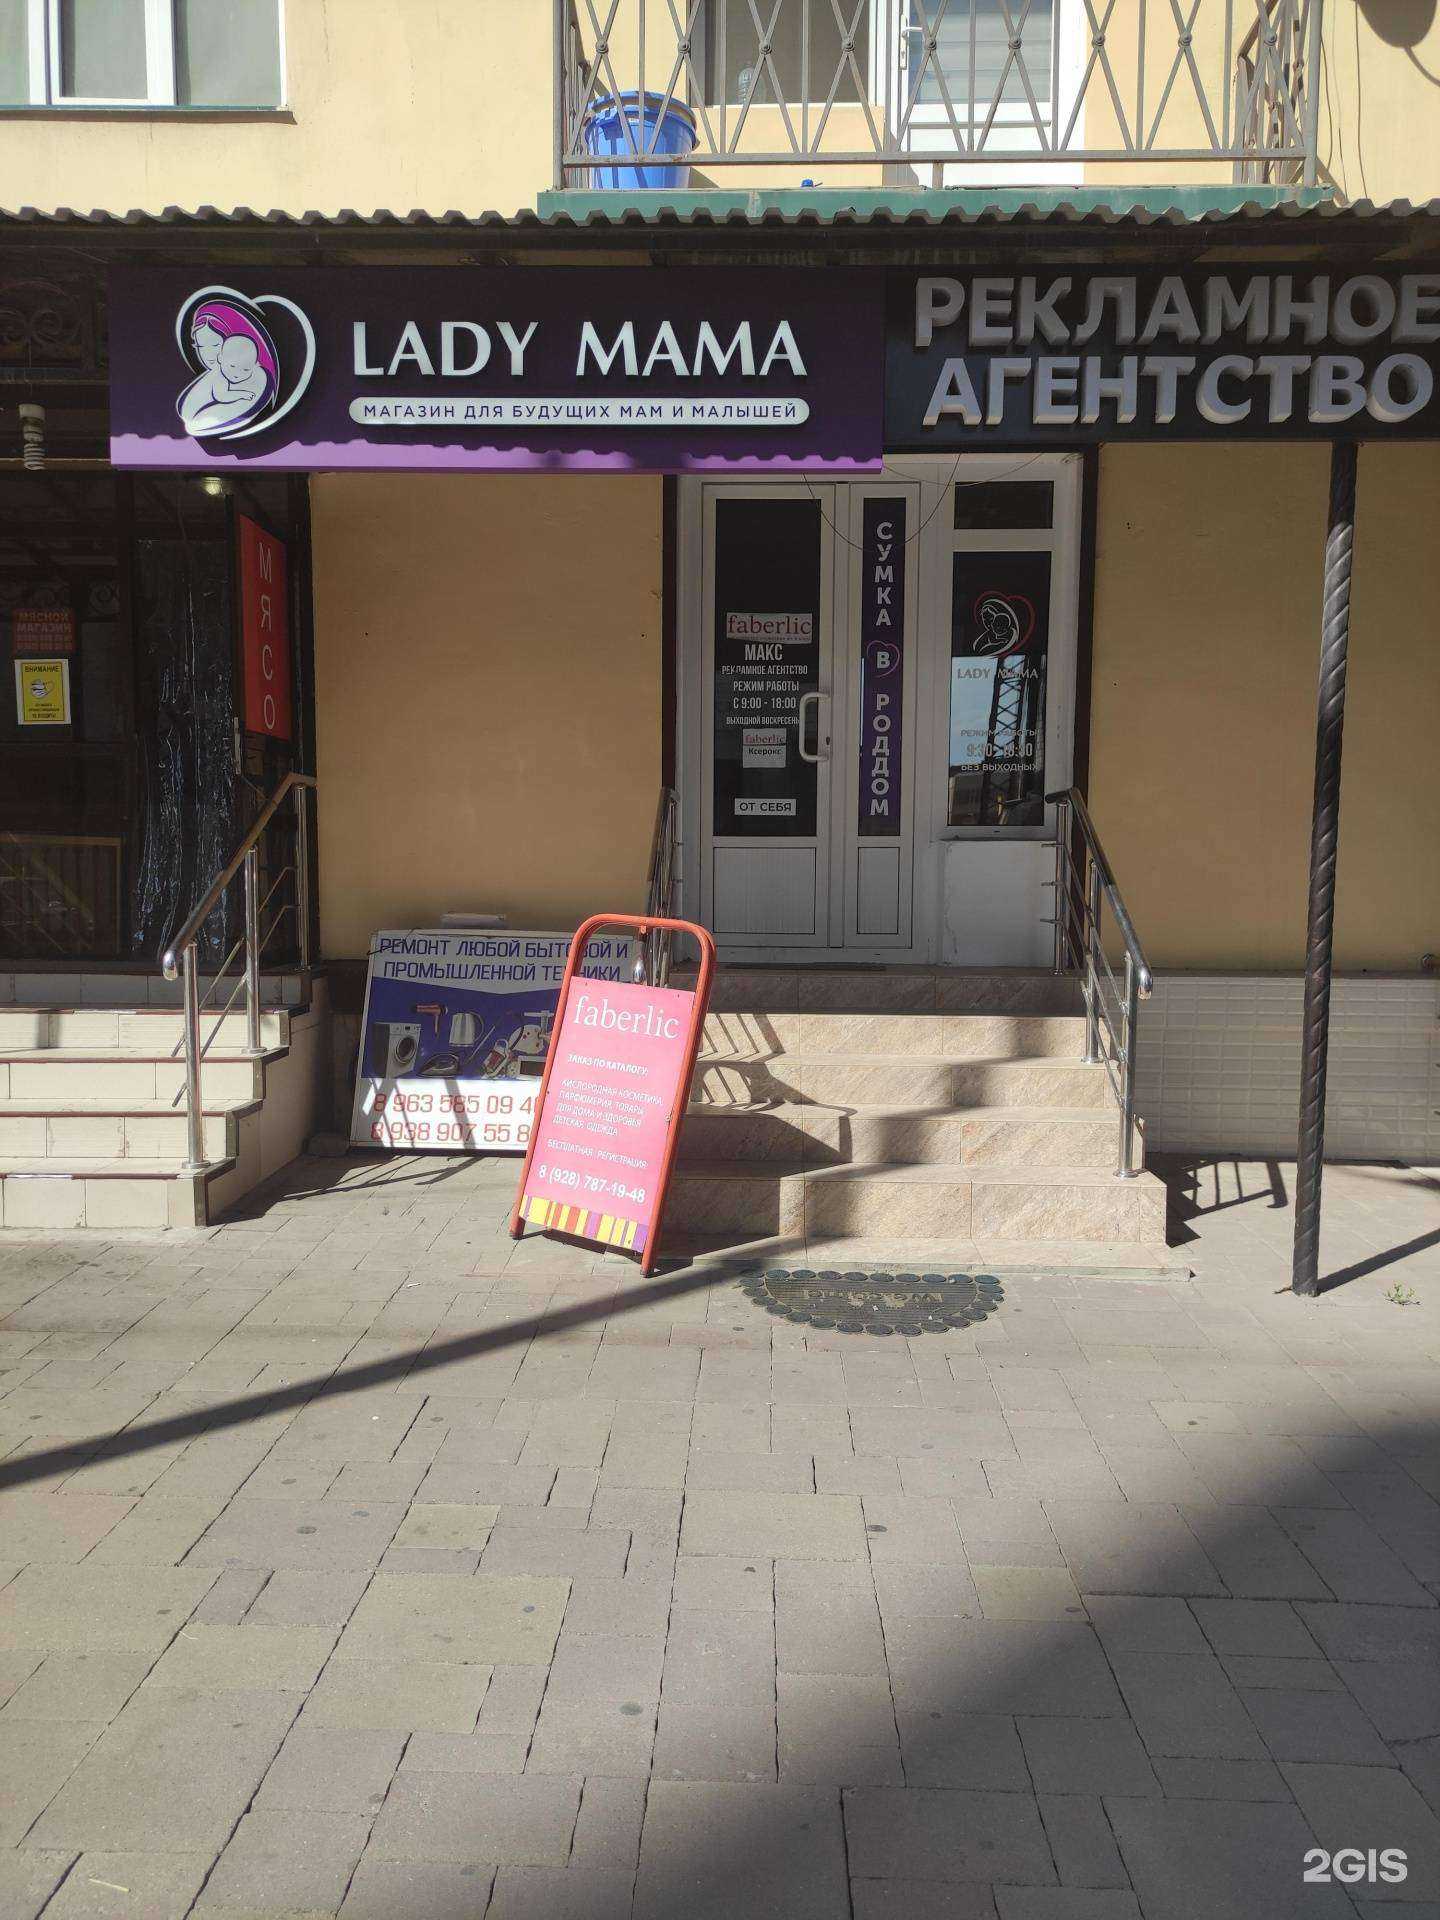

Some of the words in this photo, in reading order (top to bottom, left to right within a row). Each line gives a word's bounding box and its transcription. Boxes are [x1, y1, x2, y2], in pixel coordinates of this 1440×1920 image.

[915, 274, 1440, 347] РЕКЛАМНОЕ
[353, 321, 539, 376] LADY
[576, 321, 808, 376] MAMA
[922, 353, 1434, 426] АГЕНТСТВО
[363, 405, 455, 418] МАГАЗИН
[464, 405, 503, 420] ДЛЯ
[512, 405, 610, 420] БУДУЩИХ
[620, 405, 662, 418] МАМ
[672, 405, 684, 418] И
[692, 402, 796, 418] МАЛЫШЕЙ
[874, 521, 894, 626] СУМКА
[727, 615, 812, 634] faberlic
[259, 541, 276, 730] МЯСО
[744, 643, 783, 661] МАКС
[876, 651, 890, 669] В
[25, 664, 60, 673] ВНИМАНИЕ
[721, 664, 766, 675] РЕКЛАМНОЕ
[767, 664, 808, 675] АГЕНТСТВО
[957, 668, 991, 679] LADY
[733, 680, 764, 692] РЕЖИМ
[766, 680, 800, 692] РАБОТЫ
[733, 697, 739, 709] С
[741, 697, 762, 709] 9:00
[771, 697, 797, 709] 18:00
[726, 715, 761, 725] ВЫХОДНОЙ
[748, 746, 782, 756] Ксерокс
[870, 693, 892, 816] РОДДОМ
[739, 802, 756, 812] ОТ
[760, 802, 792, 812] СЕБЯ
[379, 939, 450, 956] РЕМОНТ
[456, 937, 521, 958] ЛЮБОЙ
[617, 943, 628, 958] И
[384, 961, 536, 980] ПРОМЫШЛЕННОЙ
[541, 964, 620, 982] ТЕНИКИ
[573, 995, 680, 1039] faberlic
[568, 1054, 592, 1067] ЗАКАЗ
[593, 1057, 606, 1068] ПО
[374, 1093, 387, 1112] 8
[393, 1094, 434, 1112] 963
[440, 1094, 482, 1114] 585
[487, 1095, 514, 1115] 09
[520, 1095, 538, 1115] 4
[371, 1121, 385, 1141] 8
[390, 1122, 431, 1142] 938
[436, 1123, 477, 1142] 907
[483, 1124, 511, 1143] 55
[539, 1164, 547, 1179] 8
[549, 1167, 581, 1190] (928)
[583, 1175, 646, 1204] 787-19-48
